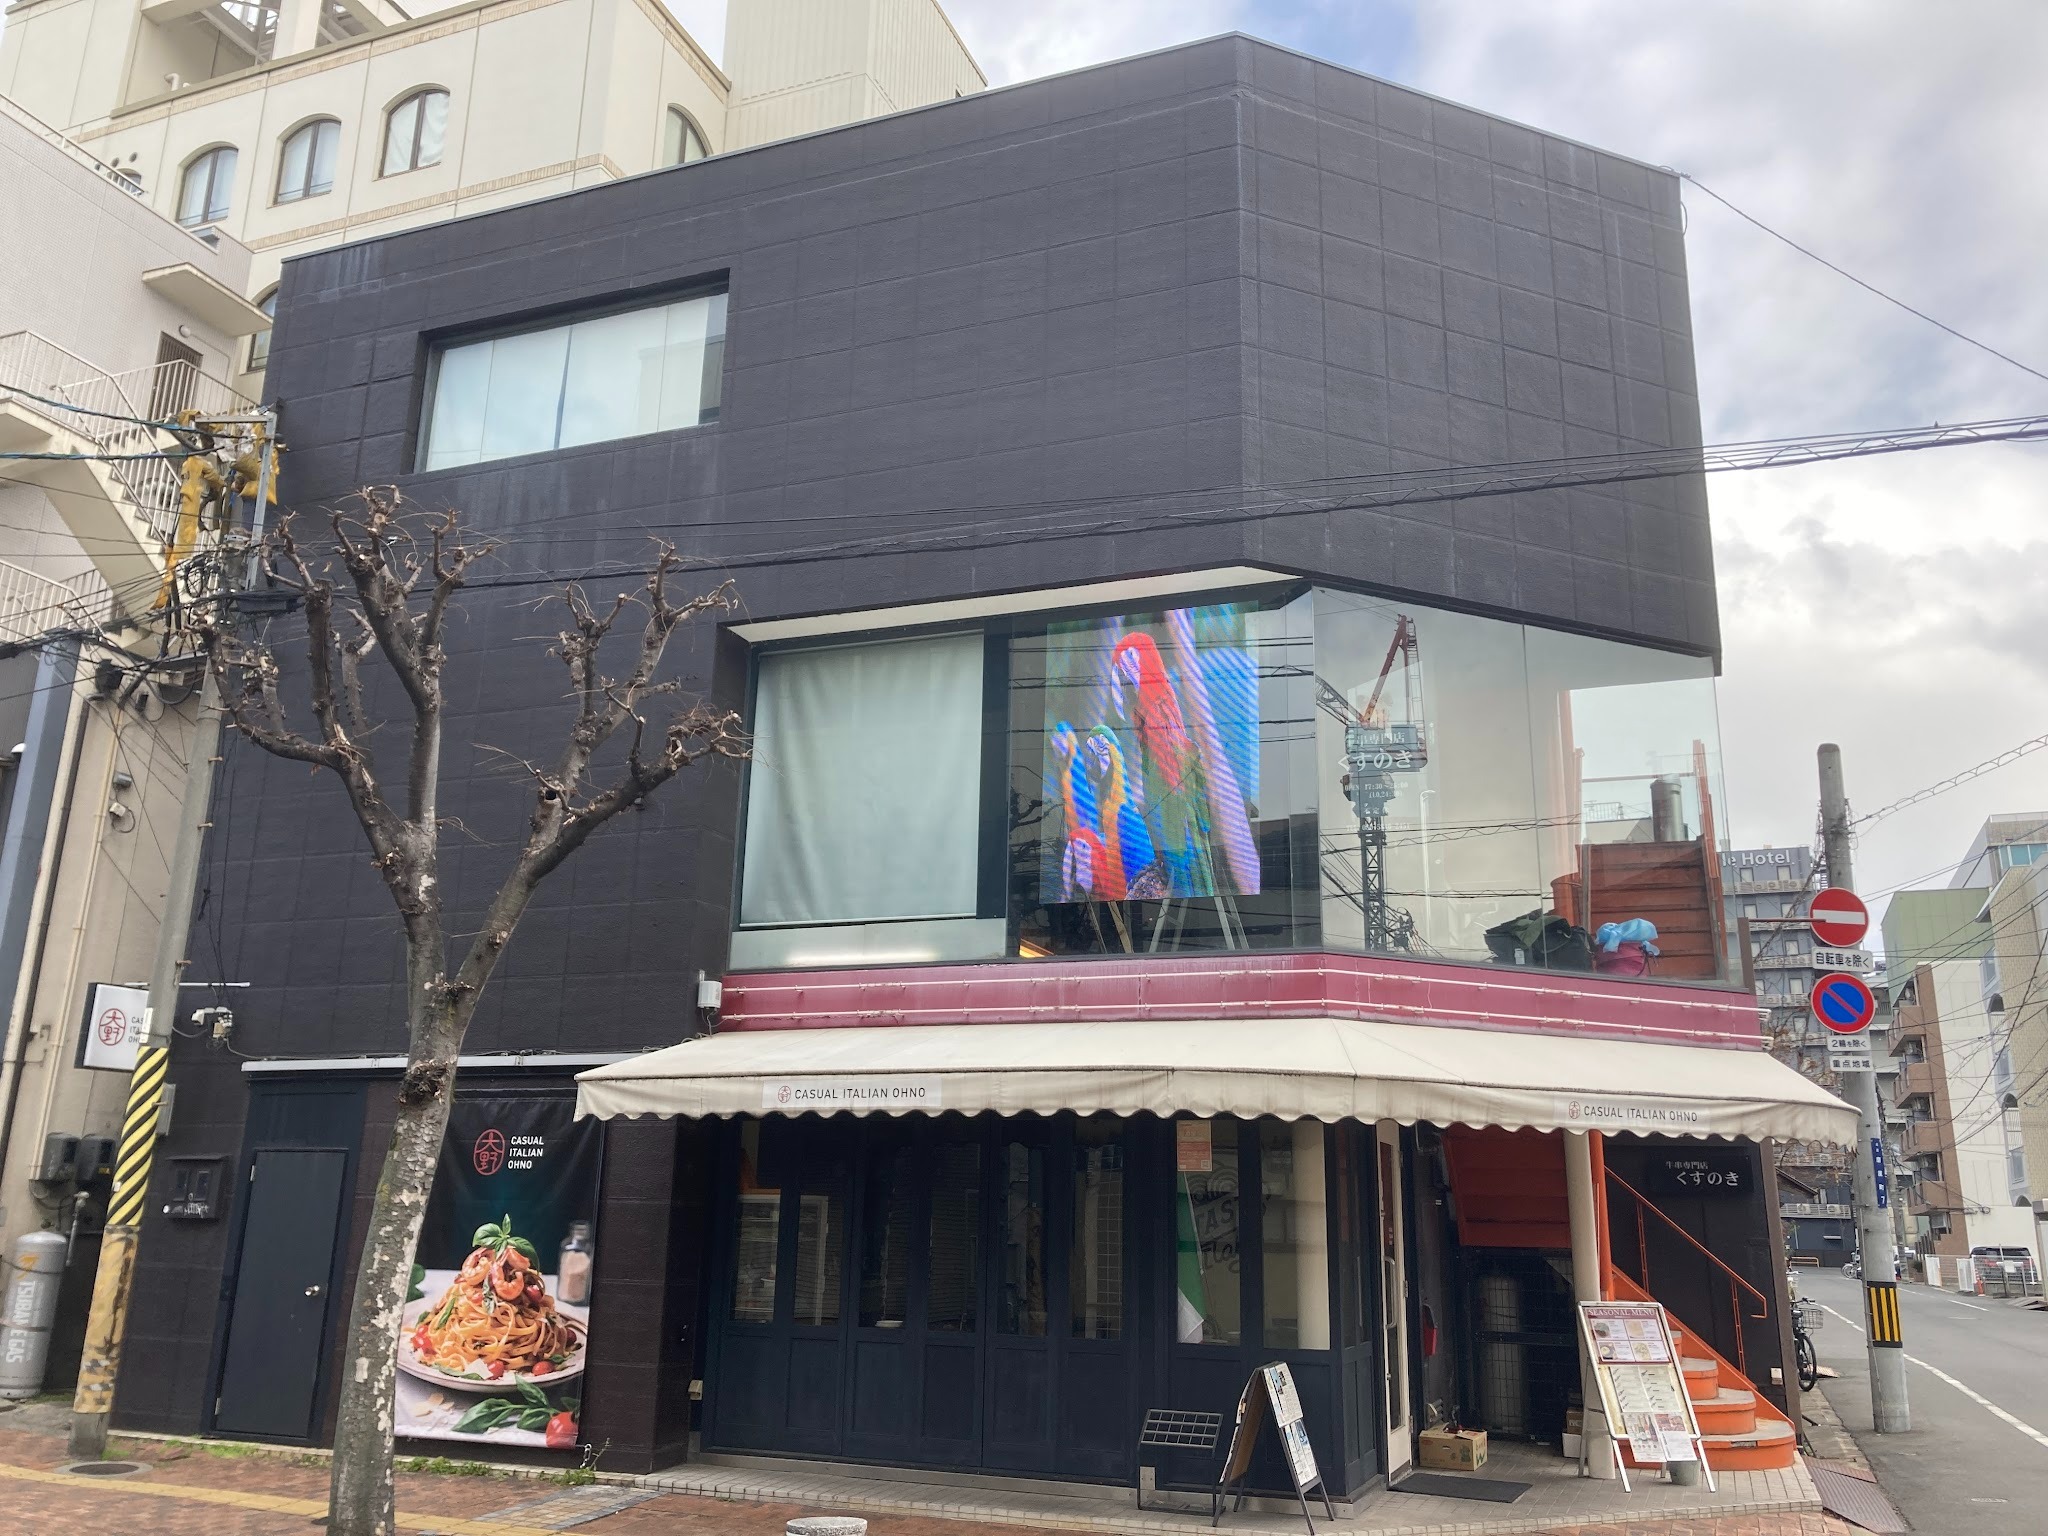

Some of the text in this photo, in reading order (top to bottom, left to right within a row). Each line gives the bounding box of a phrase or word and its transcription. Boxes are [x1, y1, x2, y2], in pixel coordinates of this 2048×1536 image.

[1338, 749, 1413, 771] くすのき
[1741, 849, 1791, 866] Hotel
[1816, 952, 1869, 968] 自転車を除く
[1832, 1039, 1866, 1048] 2輪を除く
[1832, 1059, 1870, 1068] 重点地域
[794, 1087, 926, 1100] CASUAL ITALIAN OHNO
[1583, 1105, 1698, 1122] CASUAL ITALIAN OHNO
[511, 1136, 544, 1145] CASUAL
[509, 1148, 543, 1157] ITALIAN
[507, 1160, 532, 1170] OHNO
[1676, 1170, 1739, 1186] くすのき
[6, 1338, 25, 1363] GAS
